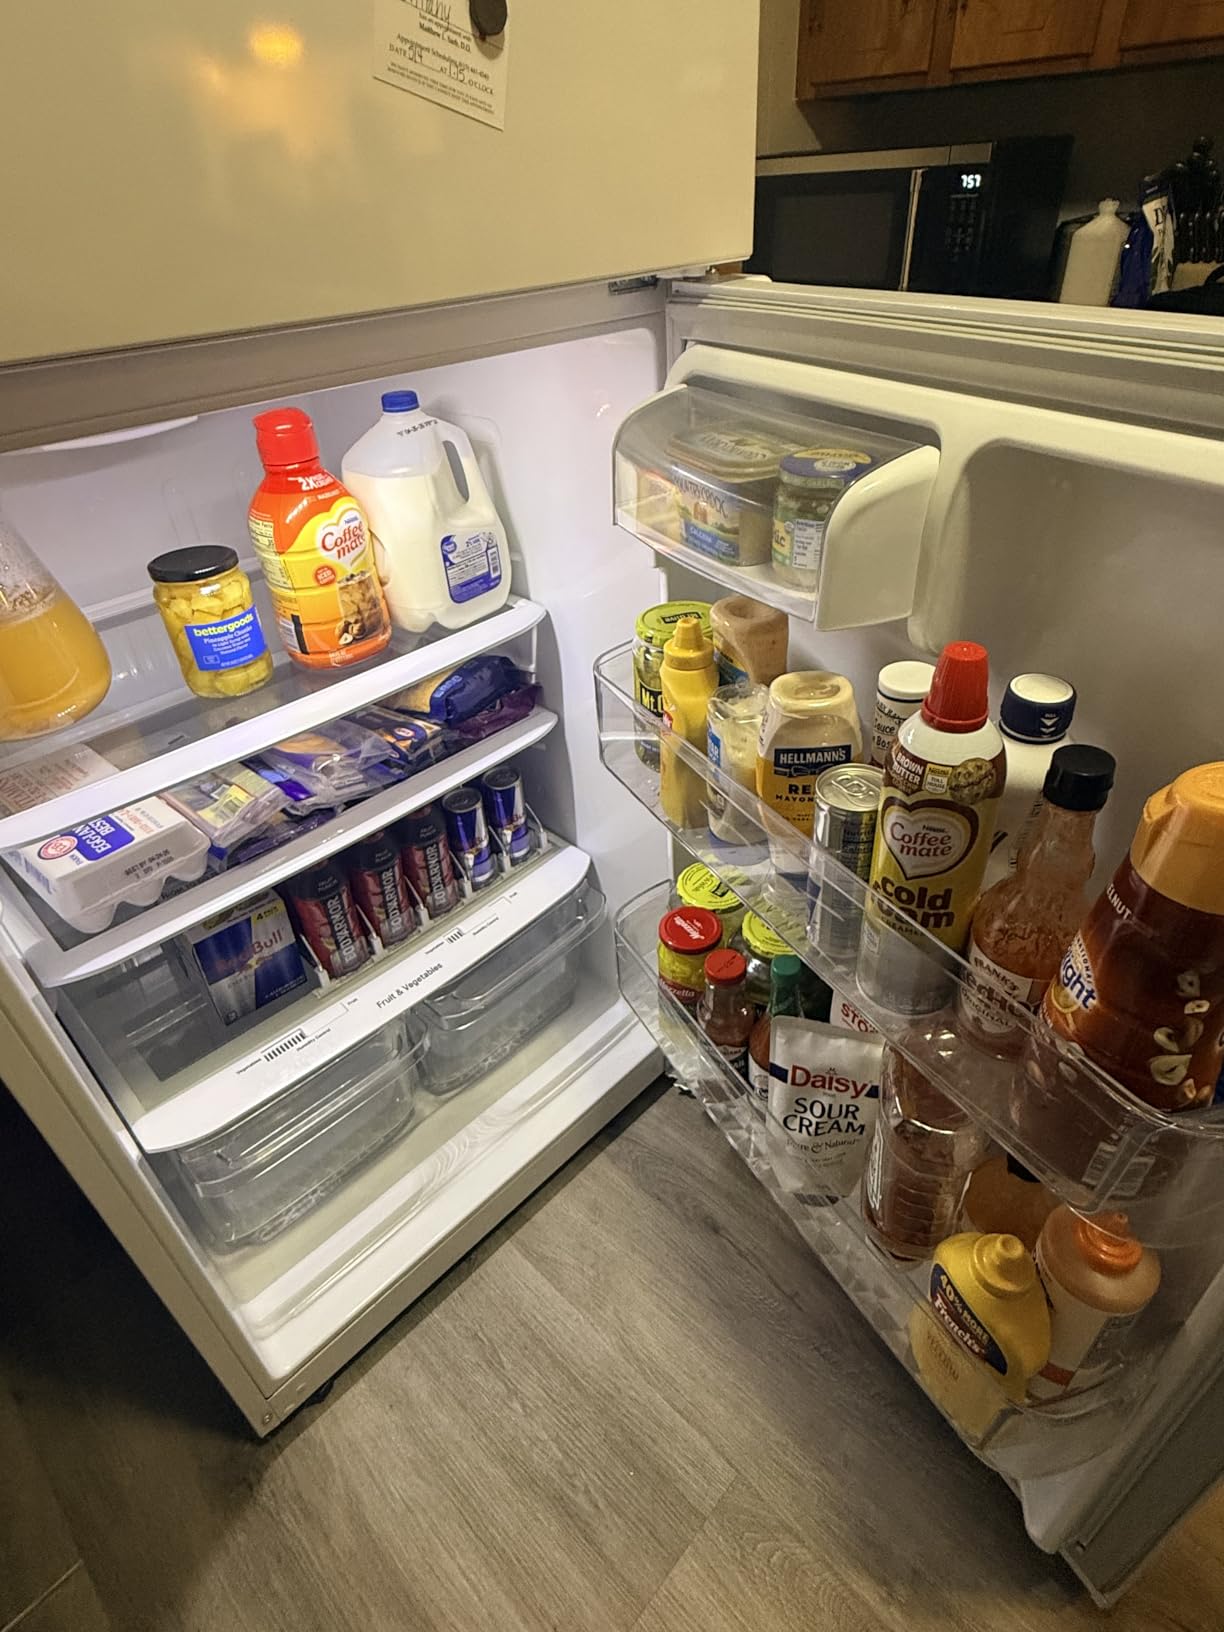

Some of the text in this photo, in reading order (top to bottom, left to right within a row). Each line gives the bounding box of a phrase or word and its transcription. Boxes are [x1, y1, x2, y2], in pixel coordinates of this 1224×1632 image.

[301, 476, 317, 491] 2X
[321, 521, 363, 552] Coffee
[193, 613, 254, 637] bettergoods
[203, 633, 234, 645] Pineapple
[780, 748, 846, 764] HELLMANN'S
[896, 753, 925, 776] BROWN
[892, 763, 921, 785] BUTTER
[890, 821, 952, 845] Coffee
[900, 843, 952, 858] mate
[881, 876, 953, 910] cold
[1106, 882, 1132, 921] ELNUT
[327, 894, 357, 964] BODYARMOR
[252, 929, 283, 955] Bull
[376, 962, 443, 1009] Fruit & Vegetables
[790, 1064, 868, 1099] Daisy
[793, 1097, 860, 1121] SOUR
[783, 1114, 866, 1137] CREAM
[824, 1138, 857, 1151] Natural
[940, 1274, 963, 1314] 40%
[962, 1309, 992, 1345] MORE
[934, 1293, 986, 1355] French's
